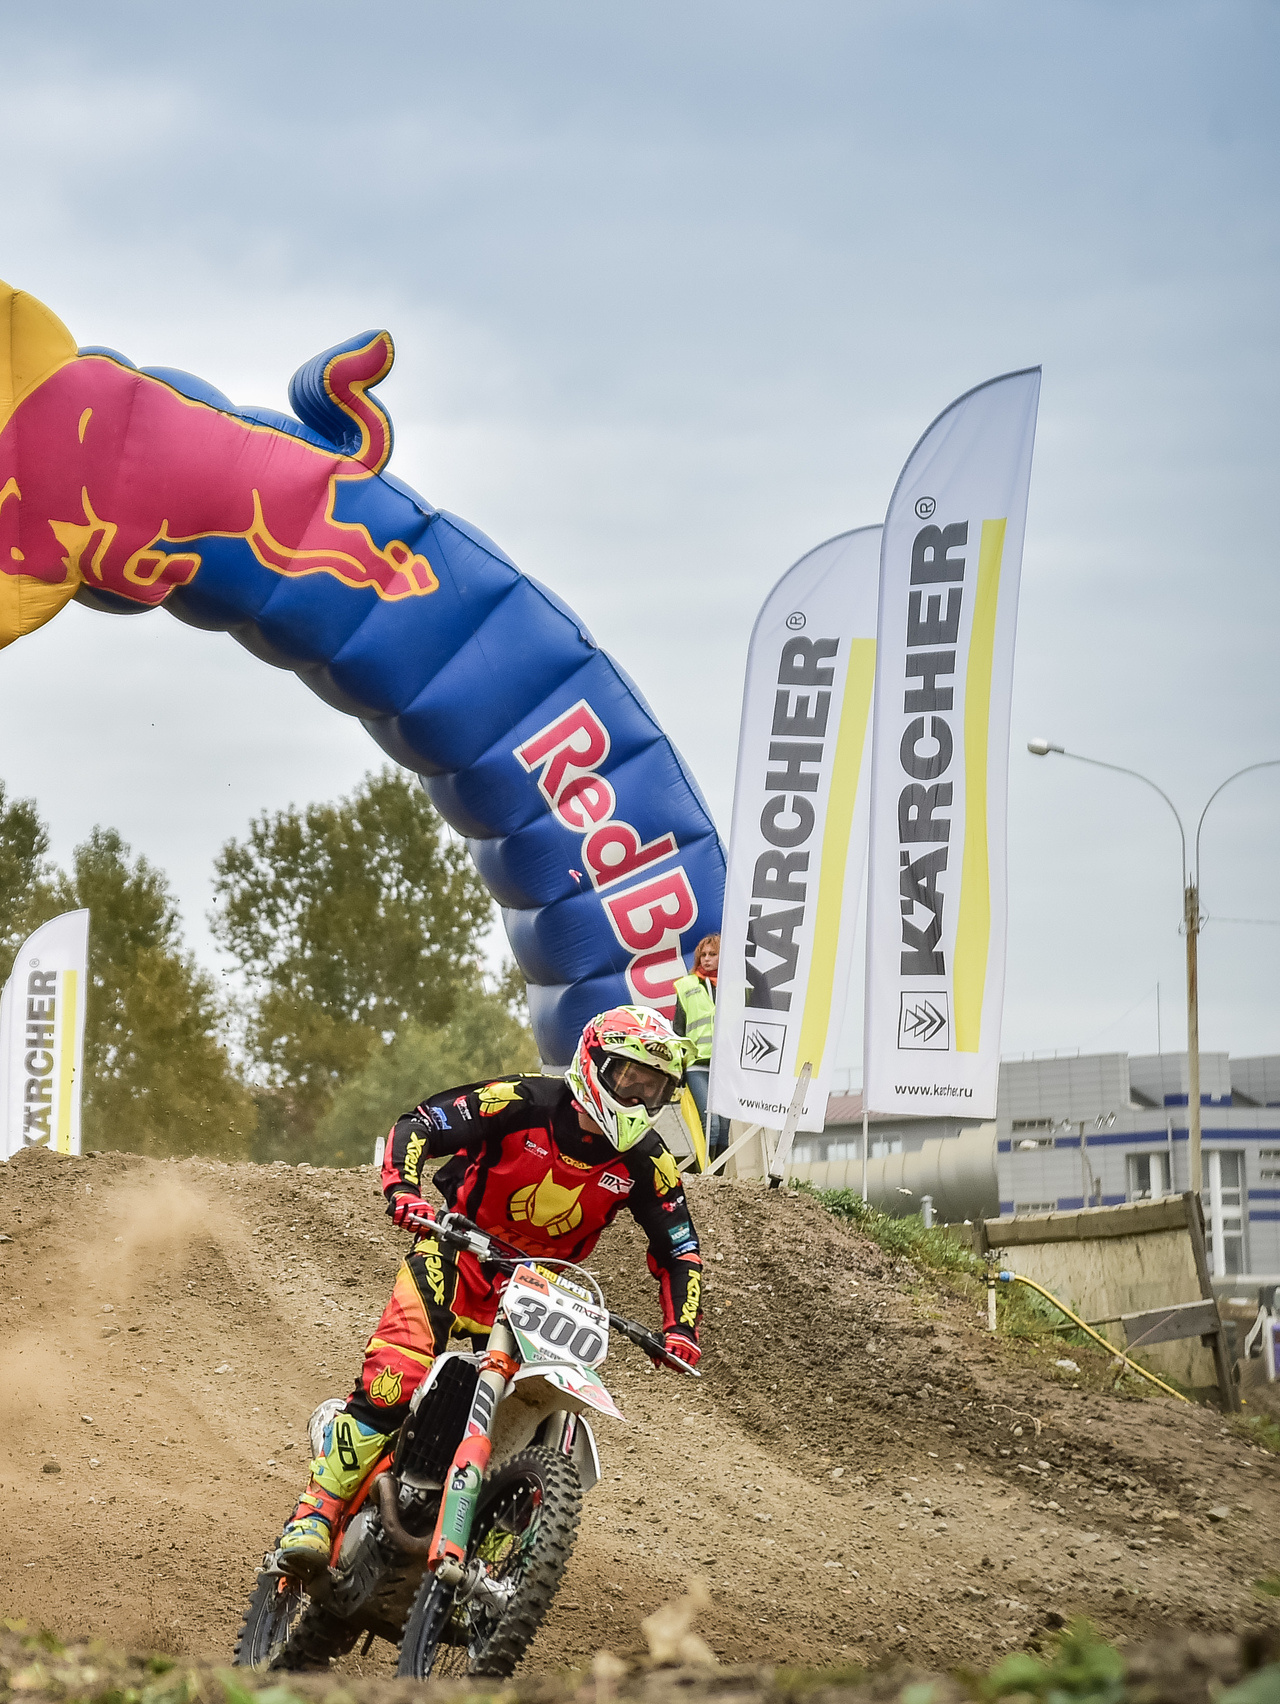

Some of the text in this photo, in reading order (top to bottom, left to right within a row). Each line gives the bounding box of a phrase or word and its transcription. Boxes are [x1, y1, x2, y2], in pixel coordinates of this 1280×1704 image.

[512, 698, 699, 1021] Red Bu
[508, 1296, 603, 1364] 300
